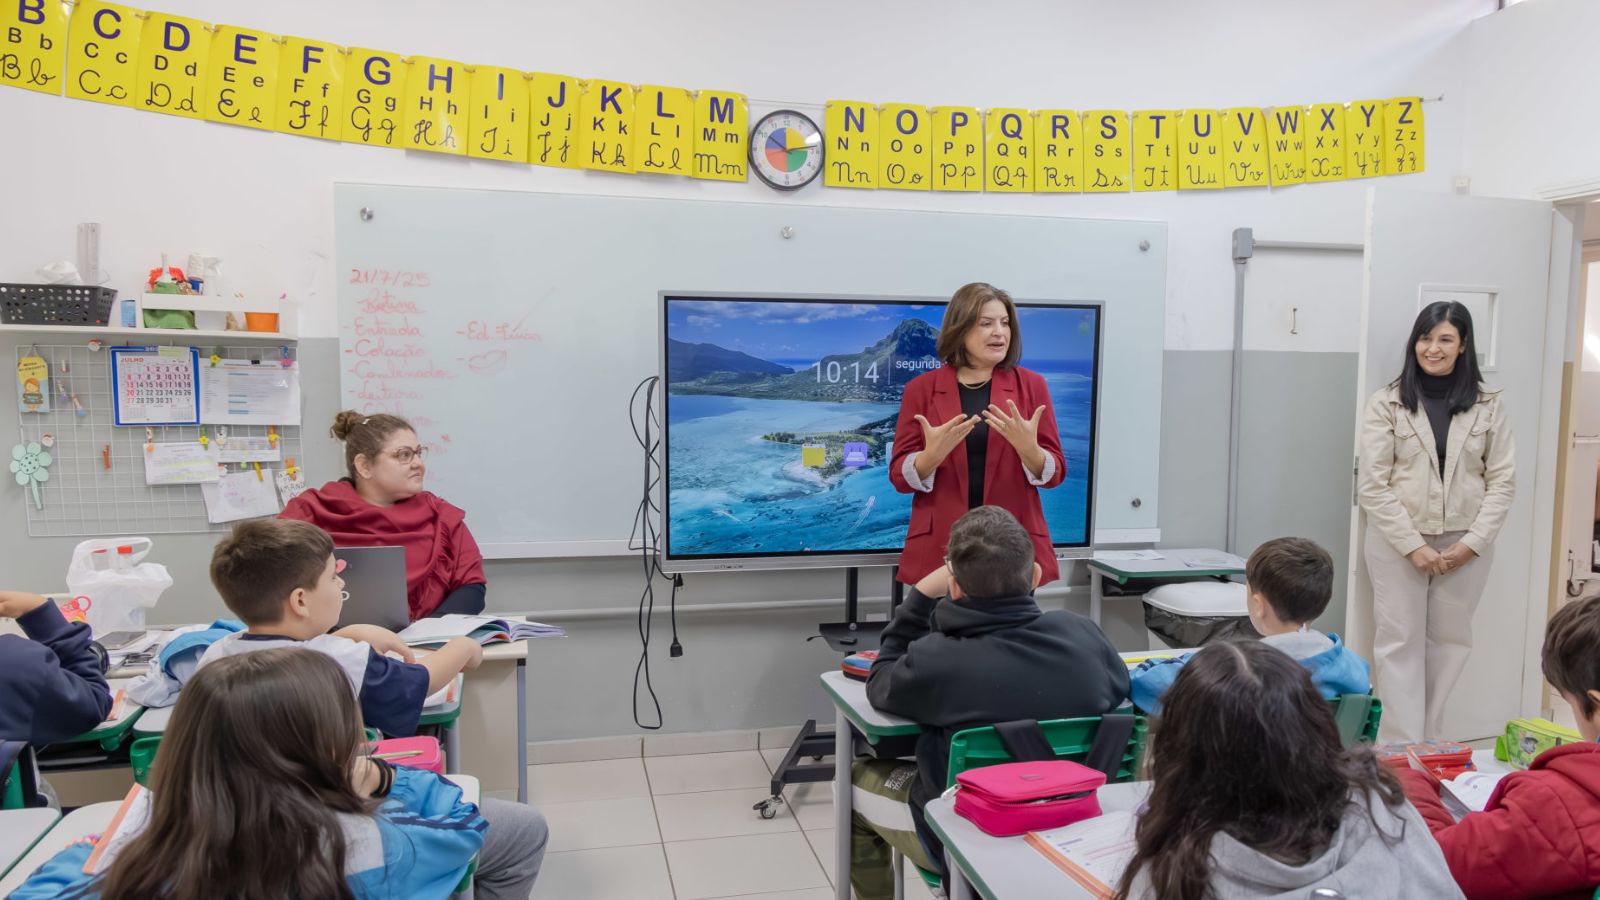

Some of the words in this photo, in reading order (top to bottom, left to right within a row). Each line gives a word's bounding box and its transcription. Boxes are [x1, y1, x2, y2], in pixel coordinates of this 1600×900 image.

[17, 0, 46, 26] B
[92, 8, 122, 40] C
[7, 26, 22, 44] B
[39, 32, 53, 51] b
[163, 20, 191, 53] D
[83, 41, 99, 59] C
[115, 51, 128, 65] c
[233, 33, 259, 66] E
[302, 45, 325, 75] F
[153, 54, 169, 71] D
[184, 61, 198, 78] d
[223, 66, 237, 83] E
[252, 75, 265, 88] e
[363, 56, 392, 86] G
[293, 77, 305, 94] F
[321, 82, 331, 99] f
[427, 63, 454, 95] H
[497, 72, 505, 101] I
[356, 88, 372, 105] G
[384, 96, 397, 113] g
[419, 95, 433, 112] H
[446, 99, 458, 116] h
[547, 80, 567, 109] J
[600, 84, 624, 115] K
[656, 90, 676, 119] L
[484, 104, 489, 120] I
[539, 111, 551, 127] J
[564, 112, 572, 132] j
[709, 96, 735, 125] M
[843, 105, 866, 134] N
[895, 108, 919, 136] O
[1275, 109, 1299, 136] W
[1319, 107, 1336, 132] X
[1360, 104, 1376, 128] Y
[1397, 101, 1414, 125] Z
[592, 116, 605, 133] K
[618, 119, 628, 136] k
[650, 121, 662, 137] L
[702, 127, 717, 143] M
[724, 131, 739, 144] m
[950, 111, 969, 137] P
[1000, 112, 1024, 141] Q
[1051, 114, 1070, 140] R
[1100, 114, 1118, 140] S
[1148, 114, 1167, 140] T
[1193, 113, 1212, 138] U
[1236, 111, 1255, 136] V
[1394, 128, 1404, 142] Z
[1409, 130, 1417, 141] z
[837, 135, 849, 151] N
[860, 141, 870, 153] n
[890, 138, 904, 153] O
[913, 143, 923, 155] o
[943, 141, 954, 156] P
[965, 143, 975, 158] p
[996, 142, 1009, 158] Q
[1018, 145, 1028, 160] q
[1046, 143, 1057, 158] R
[1067, 147, 1075, 158] r
[1094, 143, 1104, 158] S
[1114, 147, 1123, 158] s
[1144, 143, 1155, 158] T
[1165, 143, 1171, 158] t
[1188, 141, 1199, 155] U
[1208, 145, 1217, 155] u
[1232, 140, 1243, 154] V
[1252, 142, 1261, 153] v
[1275, 139, 1288, 153] W
[1293, 141, 1303, 151] w
[1315, 135, 1324, 149] X
[1332, 137, 1340, 148] x
[1355, 132, 1364, 145] Y
[1373, 134, 1381, 148] y
[812, 361, 880, 384] 10:14
